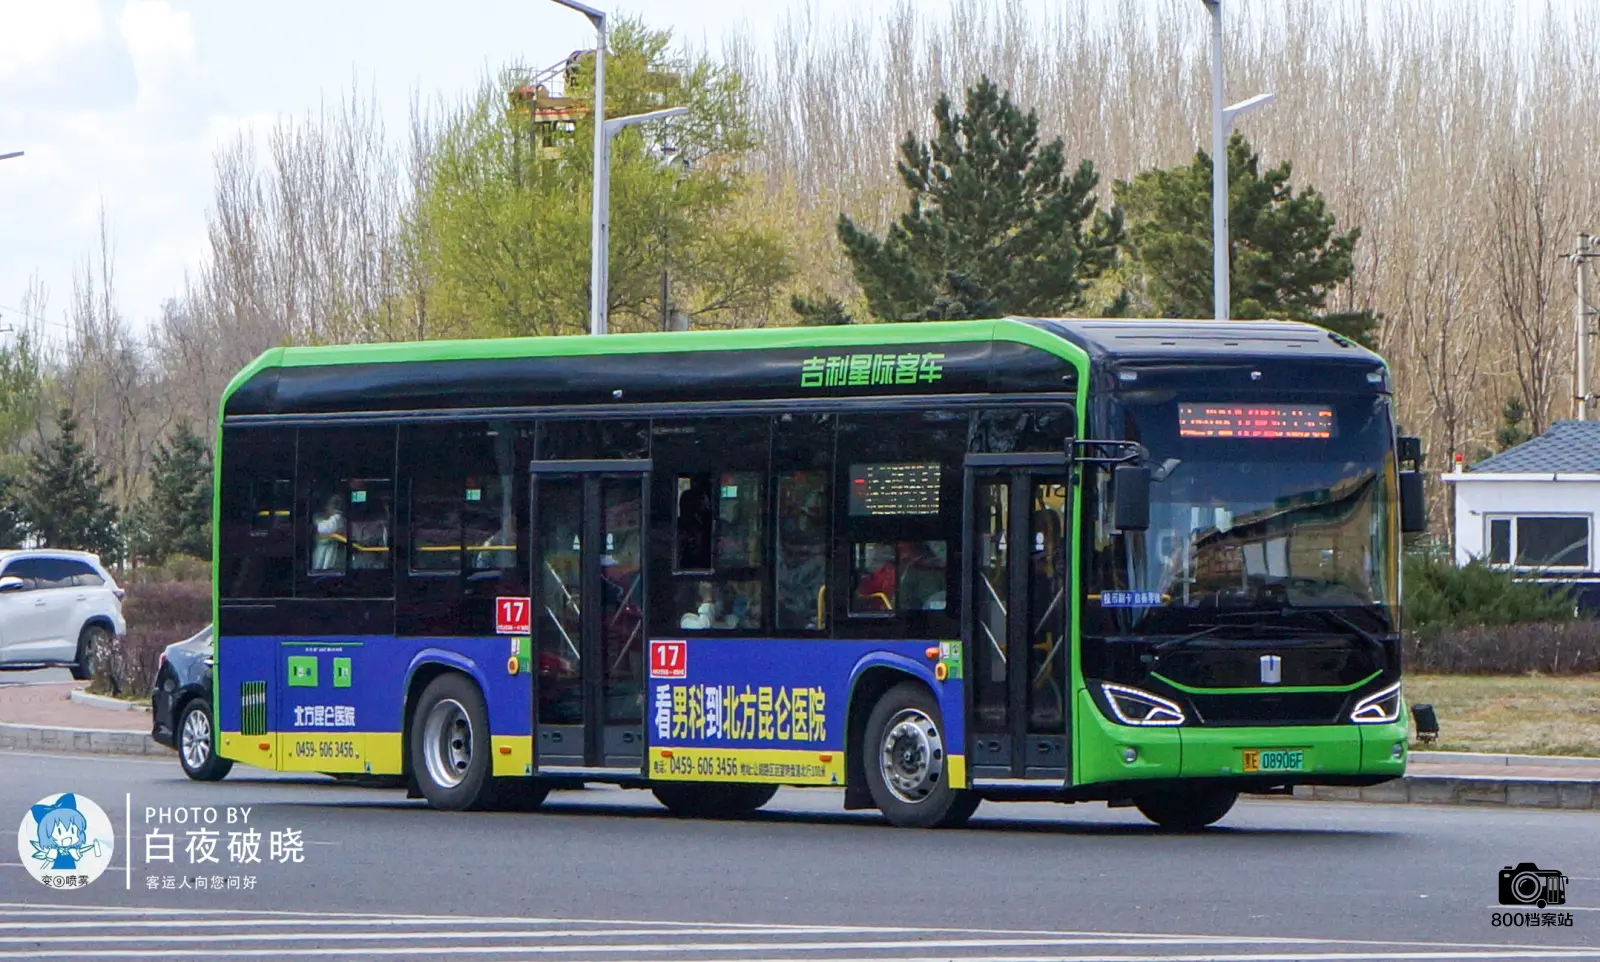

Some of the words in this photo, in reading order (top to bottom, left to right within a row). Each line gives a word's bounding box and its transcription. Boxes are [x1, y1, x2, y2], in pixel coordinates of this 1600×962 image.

[801, 352, 945, 387] 吉利星际客车
[503, 602, 524, 622] 17
[657, 645, 679, 667] 17
[294, 706, 356, 726] 北方昆仑医院
[655, 684, 827, 742] 看男科到北方昆仑医院
[1263, 752, 1303, 769] 08906F
